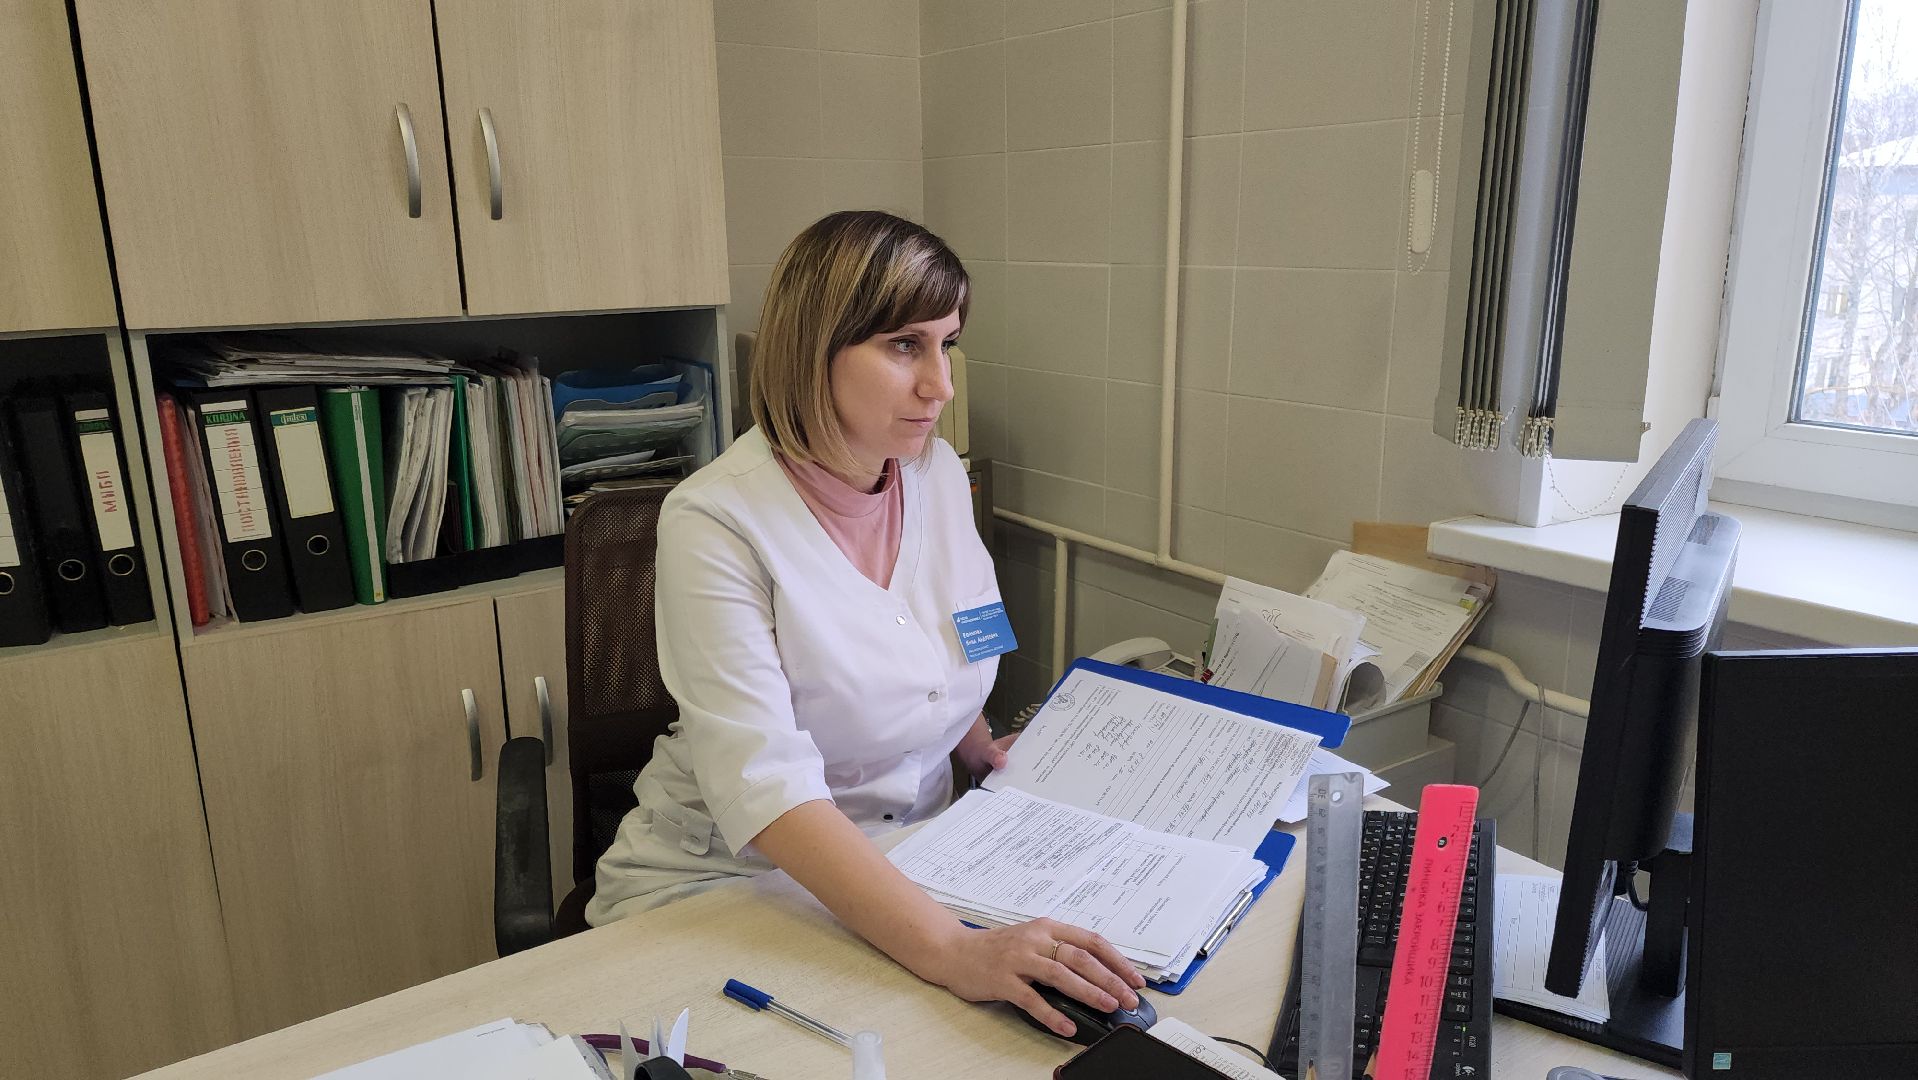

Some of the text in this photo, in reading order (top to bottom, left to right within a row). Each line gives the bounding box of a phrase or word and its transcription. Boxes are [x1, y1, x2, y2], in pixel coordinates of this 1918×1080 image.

[206, 411, 246, 425] KORONA
[1420, 976, 1433, 988] 10
[1420, 994, 1430, 1007] 11
[1413, 1012, 1427, 1025] 12
[1410, 1032, 1423, 1044] 13
